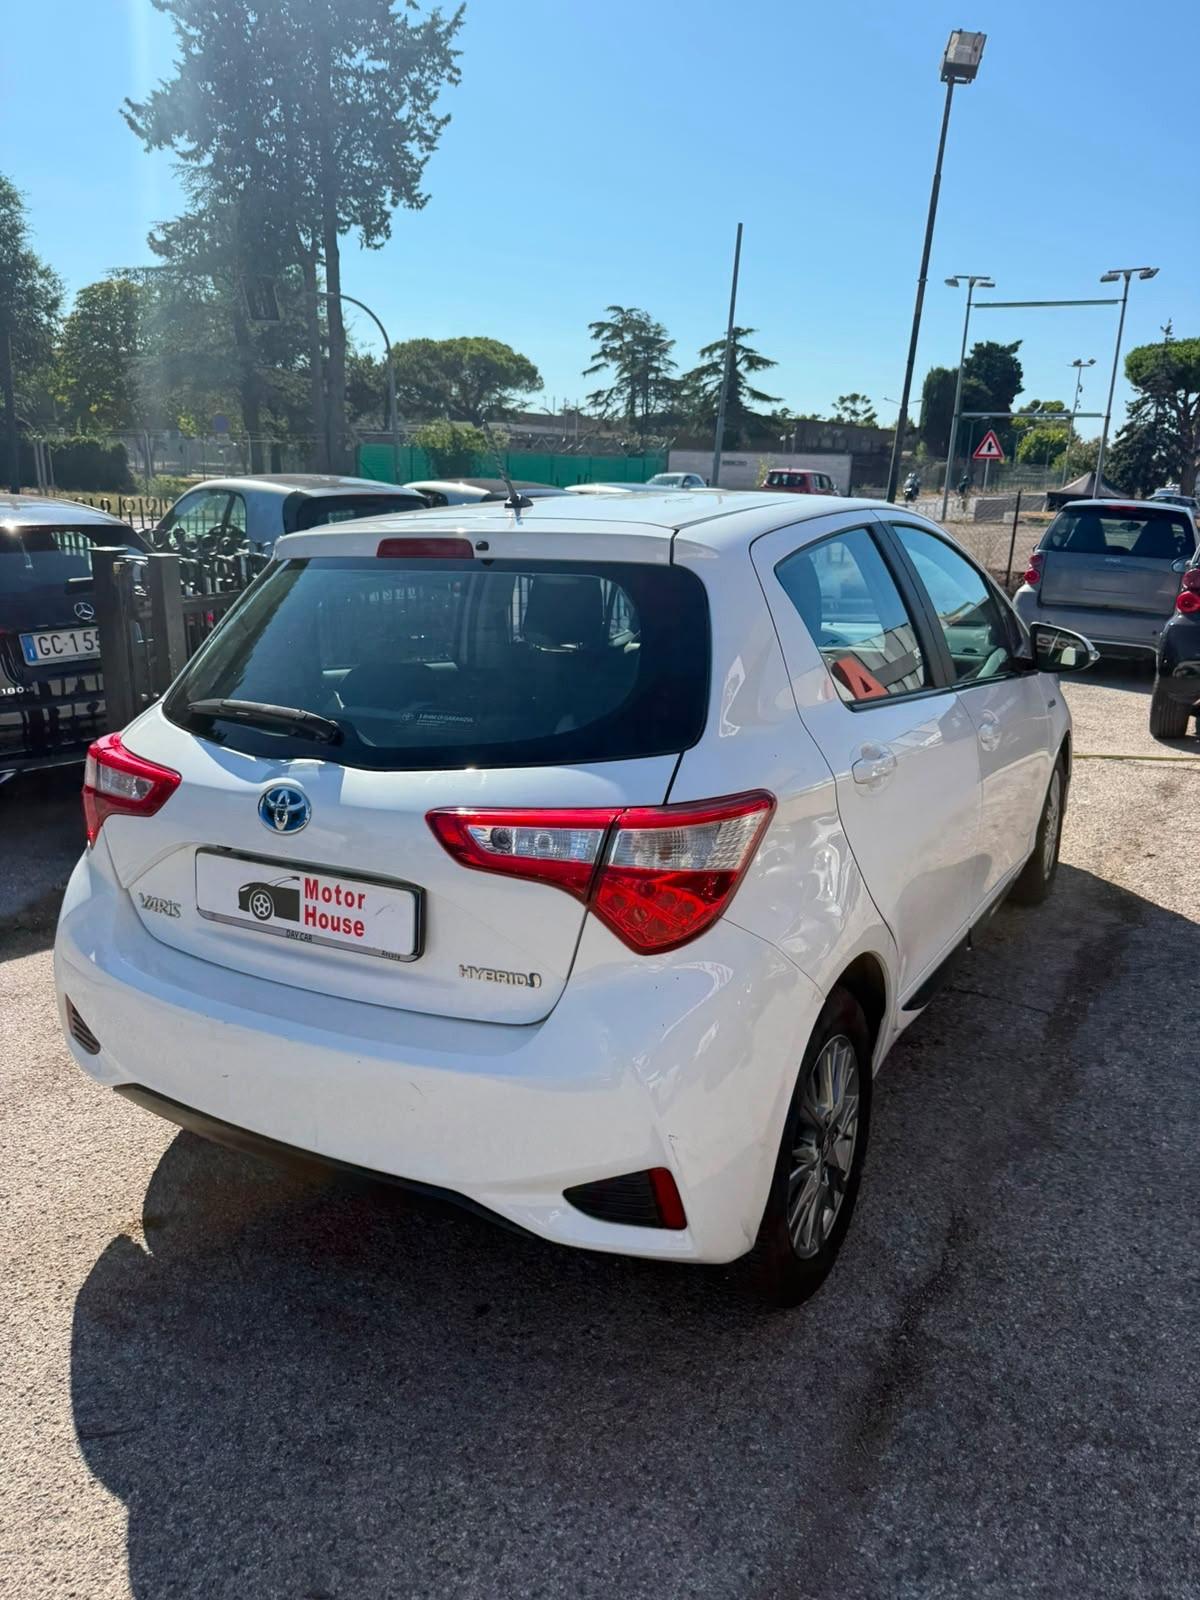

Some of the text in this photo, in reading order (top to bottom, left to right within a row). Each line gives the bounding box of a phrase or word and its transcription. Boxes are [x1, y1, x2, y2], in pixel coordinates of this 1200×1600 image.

[138, 892, 182, 919] YARIS
[304, 877, 366, 910] Motor
[304, 904, 365, 937] House
[458, 963, 529, 987] HYBRID
